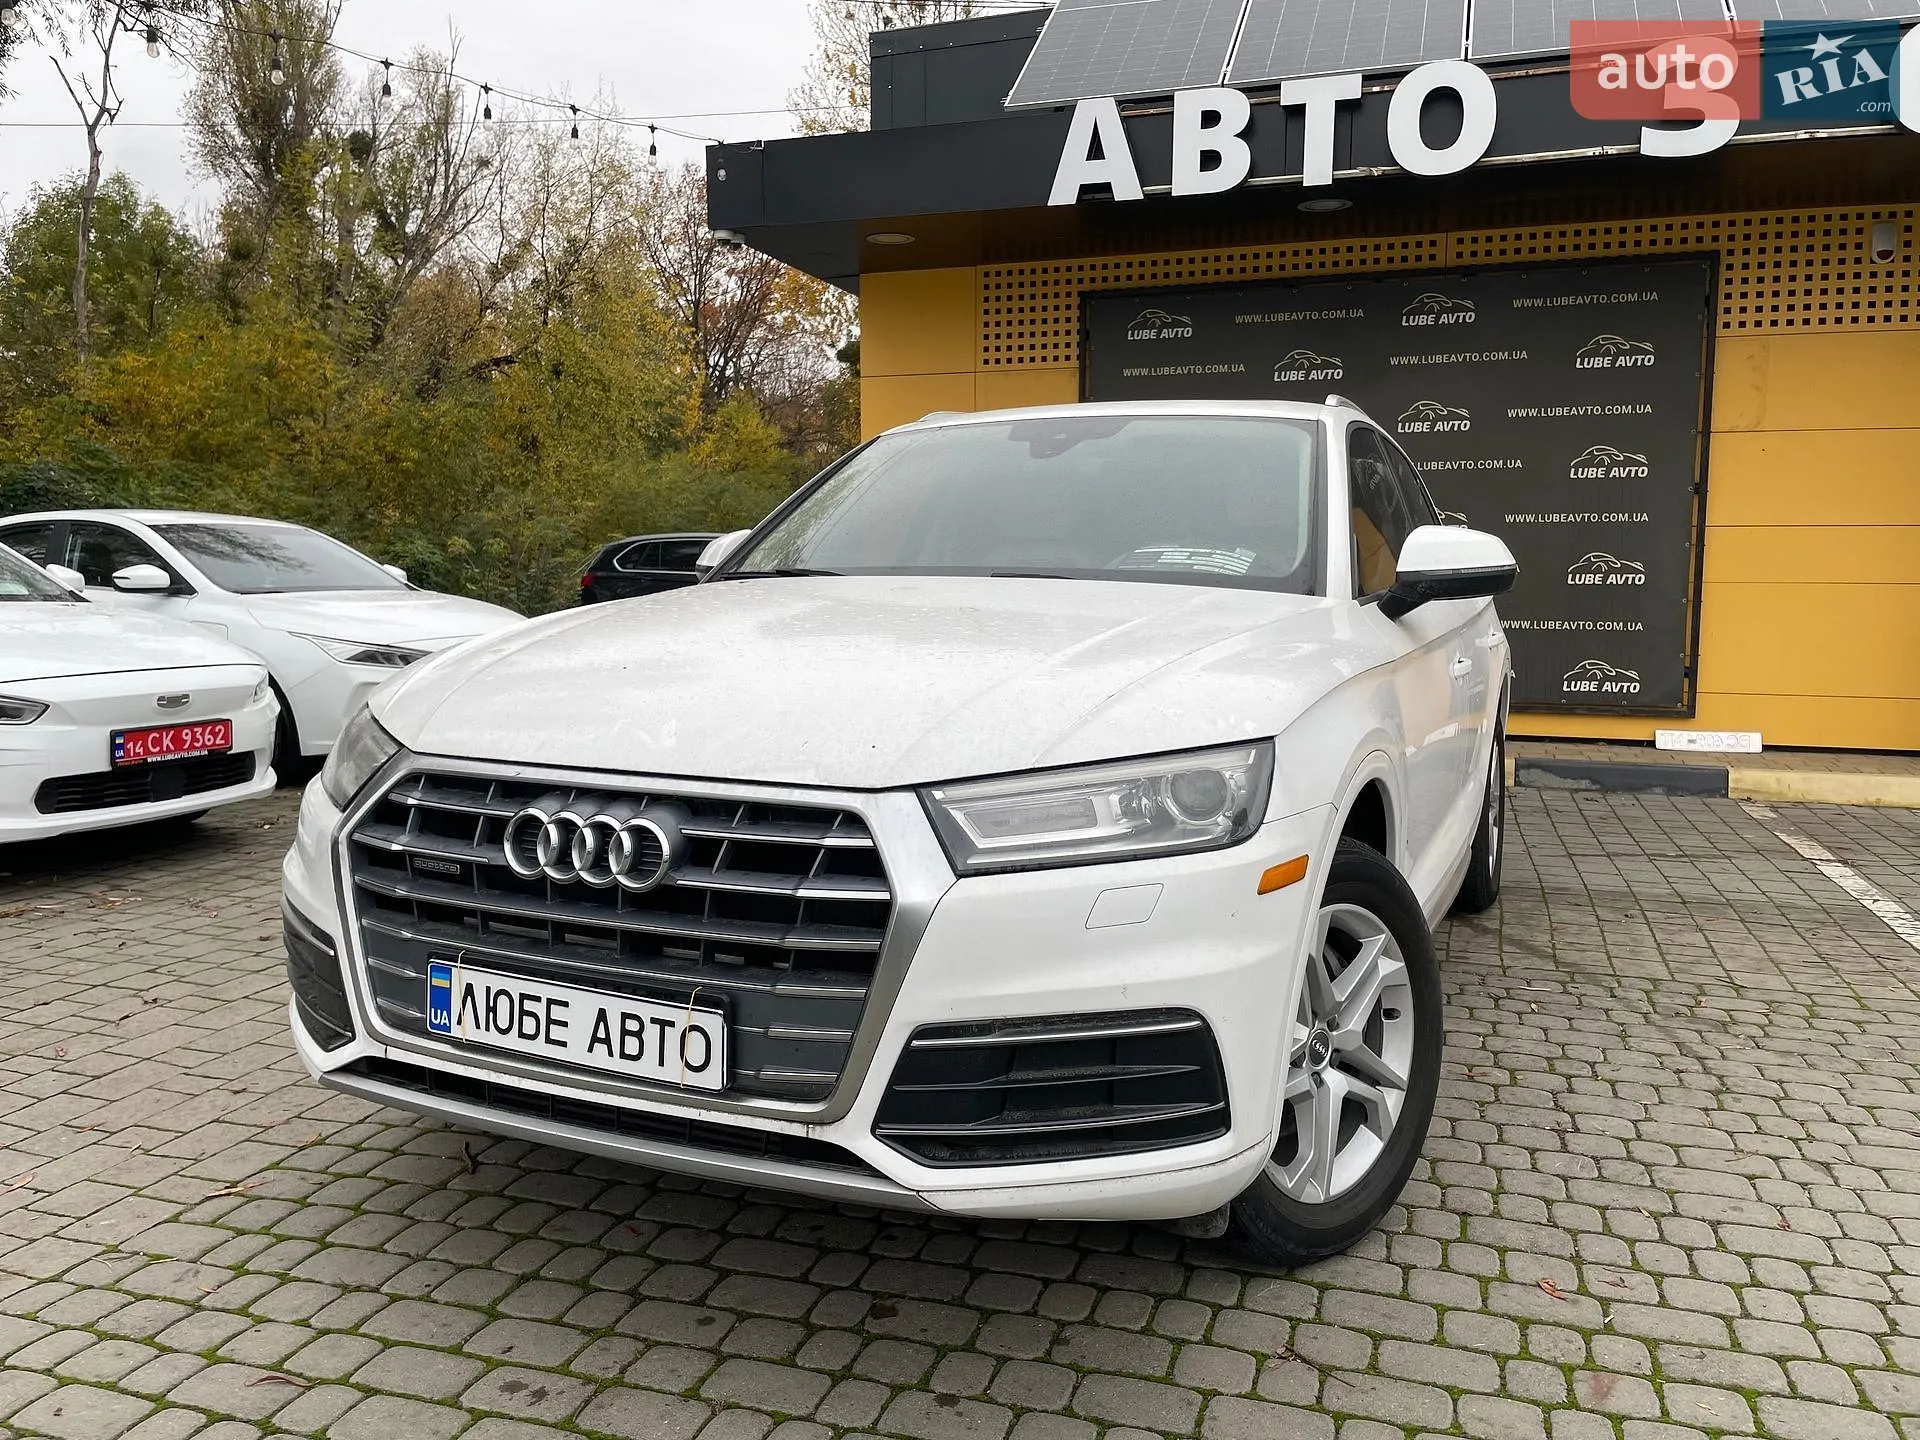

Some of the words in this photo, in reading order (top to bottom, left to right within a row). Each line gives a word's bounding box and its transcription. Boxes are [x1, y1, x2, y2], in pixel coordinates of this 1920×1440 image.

[1047, 59, 1498, 206] АВТО
[1513, 291, 1659, 309] WWW.LUBEAVTO.COM.UA
[1235, 308, 1364, 324] WWW.LUBEAVTO.COM.UA
[1401, 314, 1436, 326] LUBE
[1438, 311, 1476, 325] AVTO
[1127, 329, 1158, 341] LUBE
[1160, 327, 1193, 339] AVTO
[1389, 350, 1528, 366] WWW.LUBEAVTO.COM.UA
[1575, 356, 1612, 369] LUBE
[1615, 354, 1655, 368] AVTO
[1122, 363, 1246, 377] WWW.LUBEAVTO.COM.UA
[1273, 370, 1306, 382] LUBE
[1308, 368, 1343, 381] AVTO
[1507, 404, 1653, 418] WWW.LUBEAVTO.COM.UA
[1397, 421, 1431, 433] LUBE
[1433, 420, 1471, 432] AVTO
[1569, 467, 1606, 479] LUBE
[1609, 466, 1649, 478] AVTO
[1504, 512, 1649, 524] WWW.LUBEAVTO.COM.UA
[1567, 573, 1603, 585] LUBE
[1606, 573, 1646, 585] AVTO
[1500, 620, 1644, 632] WWW.LUBEAVTO.COM.UA
[1562, 680, 1599, 693] LUBE
[1601, 681, 1641, 694] AVTO
[127, 741, 144, 757] 14
[147, 730, 175, 753] CK
[182, 724, 226, 749] 9362
[414, 860, 458, 873] quattro
[430, 1008, 450, 1027] UA
[456, 982, 570, 1048] ЛЮБЕ
[587, 1007, 712, 1073] АВТО
